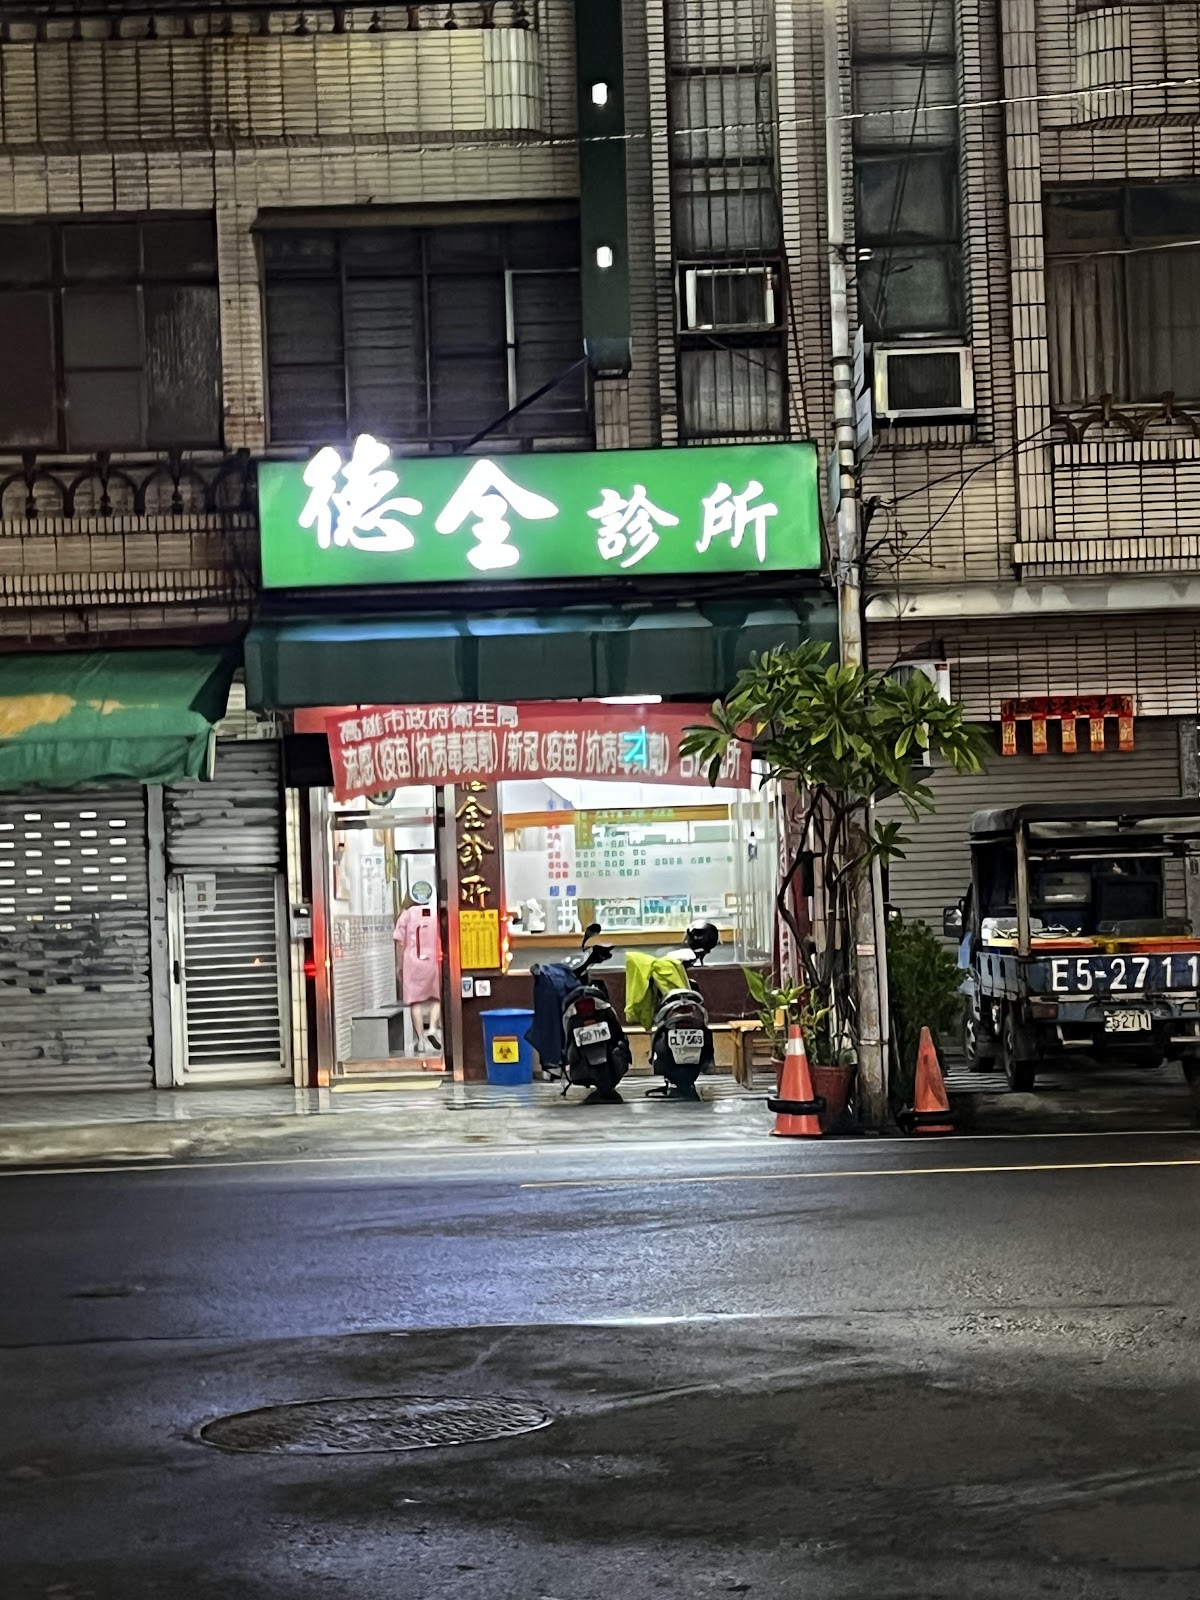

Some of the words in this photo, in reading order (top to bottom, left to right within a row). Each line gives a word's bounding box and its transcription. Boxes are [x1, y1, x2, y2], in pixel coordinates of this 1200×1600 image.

[298, 433, 779, 571] 德全診所
[338, 705, 519, 744] 高雄市政府衛生局
[1051, 955, 1199, 992] E5-2711
